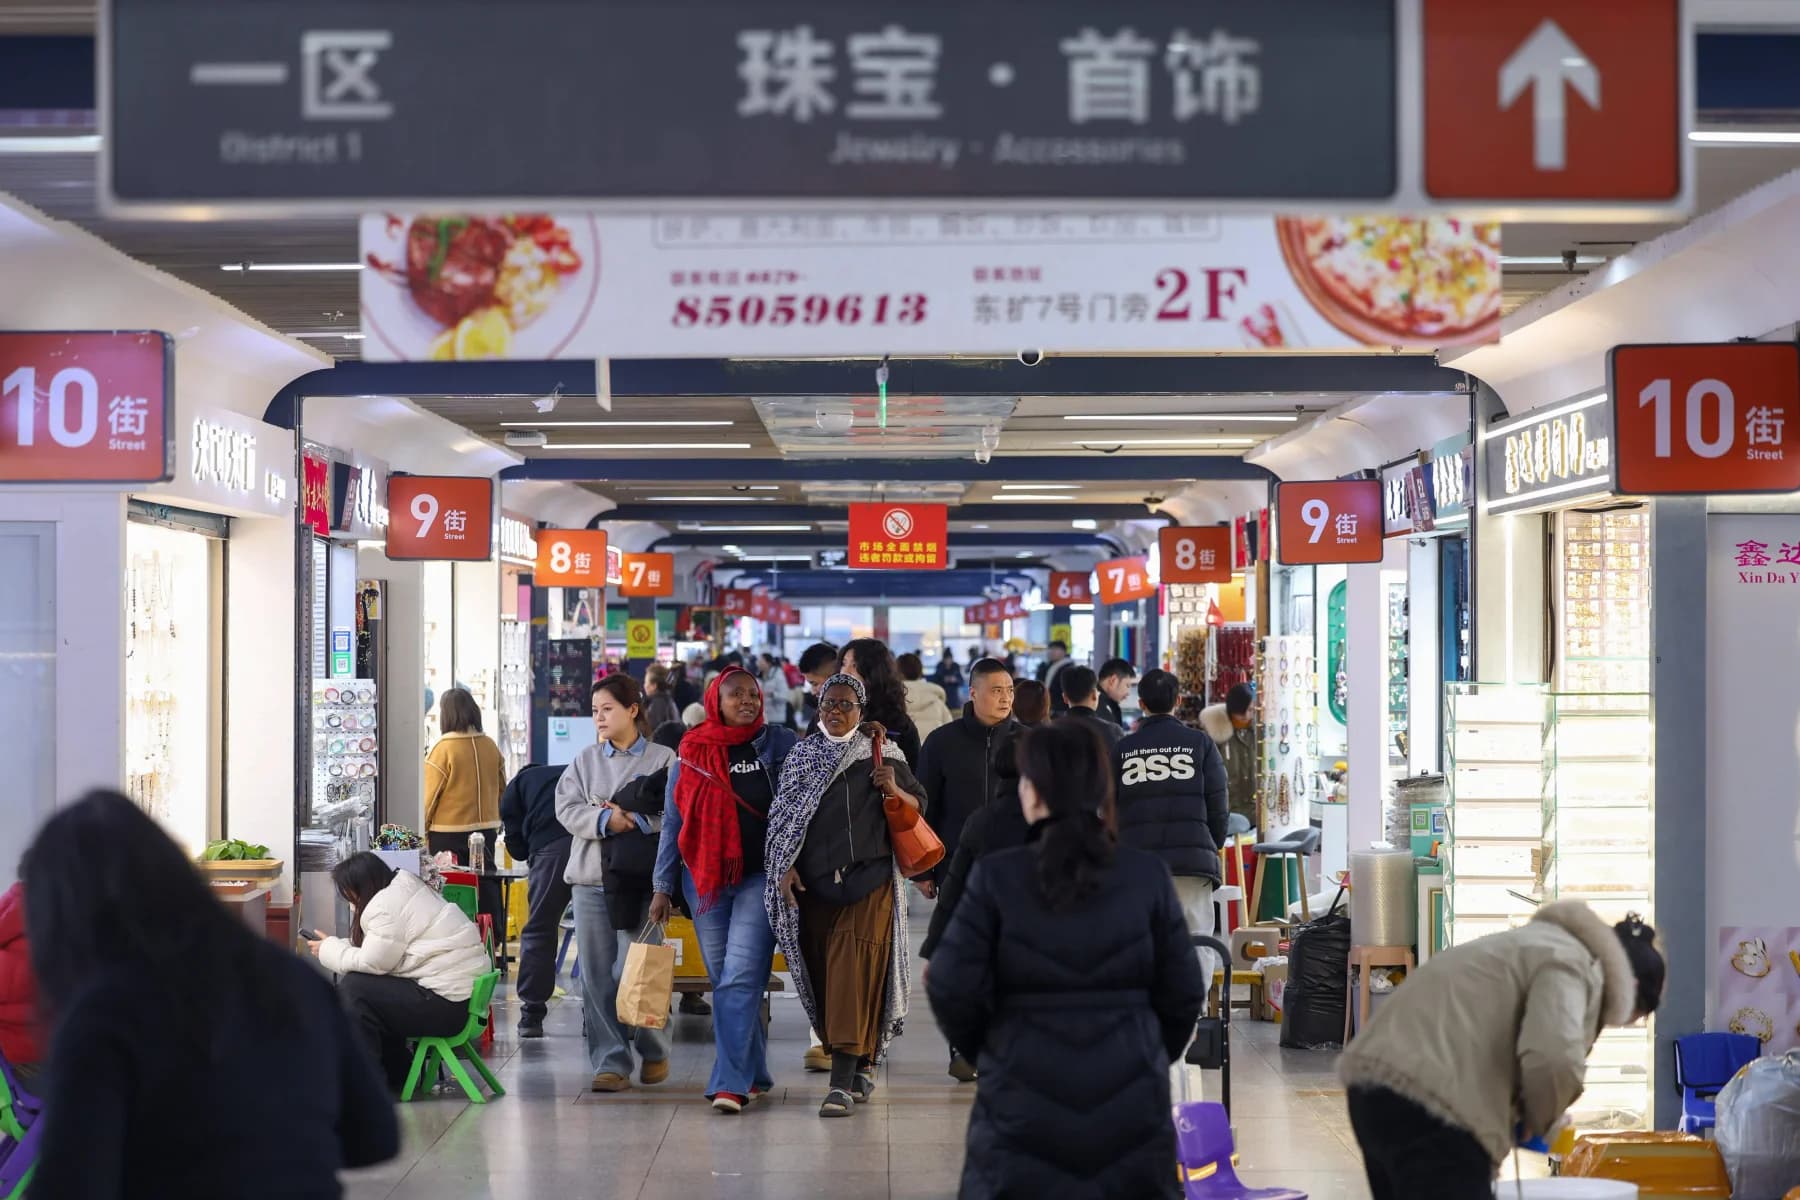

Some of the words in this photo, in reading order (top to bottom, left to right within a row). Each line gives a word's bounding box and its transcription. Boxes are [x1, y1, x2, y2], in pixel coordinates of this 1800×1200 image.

[190, 30, 393, 121] 一区
[219, 131, 338, 163] District
[346, 131, 362, 163] 1
[829, 131, 960, 169] Jewelry
[992, 131, 1187, 164] Accessories
[671, 293, 928, 327] 85059613
[1155, 267, 1247, 321] 2F
[109, 439, 145, 451] Street
[1746, 448, 1783, 460] Street
[1738, 571, 1762, 583] Xin
[1767, 571, 1784, 584] Da
[1125, 749, 1138, 759] pull
[1139, 747, 1158, 755] them
[1122, 753, 1195, 786] ass
